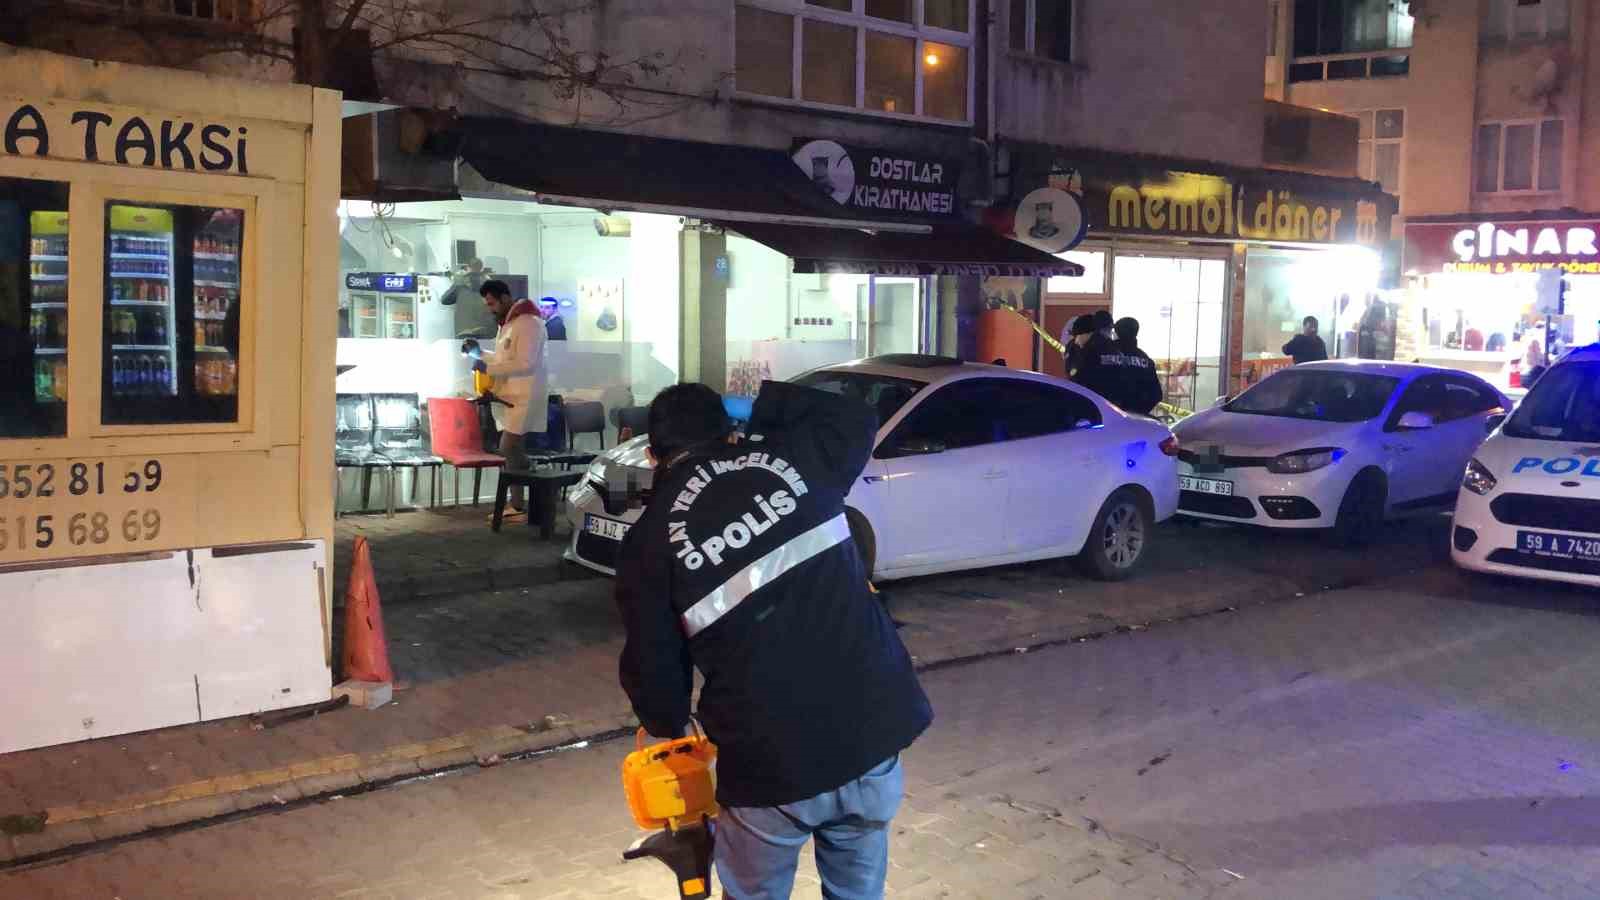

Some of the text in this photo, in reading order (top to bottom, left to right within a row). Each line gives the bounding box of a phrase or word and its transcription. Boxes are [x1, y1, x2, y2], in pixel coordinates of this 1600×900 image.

[4, 105, 49, 156] A
[870, 156, 943, 184] DOSTLAR
[1255, 189, 1342, 242] döner
[69, 462, 104, 495] 81
[68, 511, 110, 546] 68
[121, 509, 161, 542] 69
[669, 520, 704, 570] OLAY
[1527, 534, 1543, 549] 59
[1551, 537, 1559, 552] A
[1567, 538, 1600, 556] 7420
